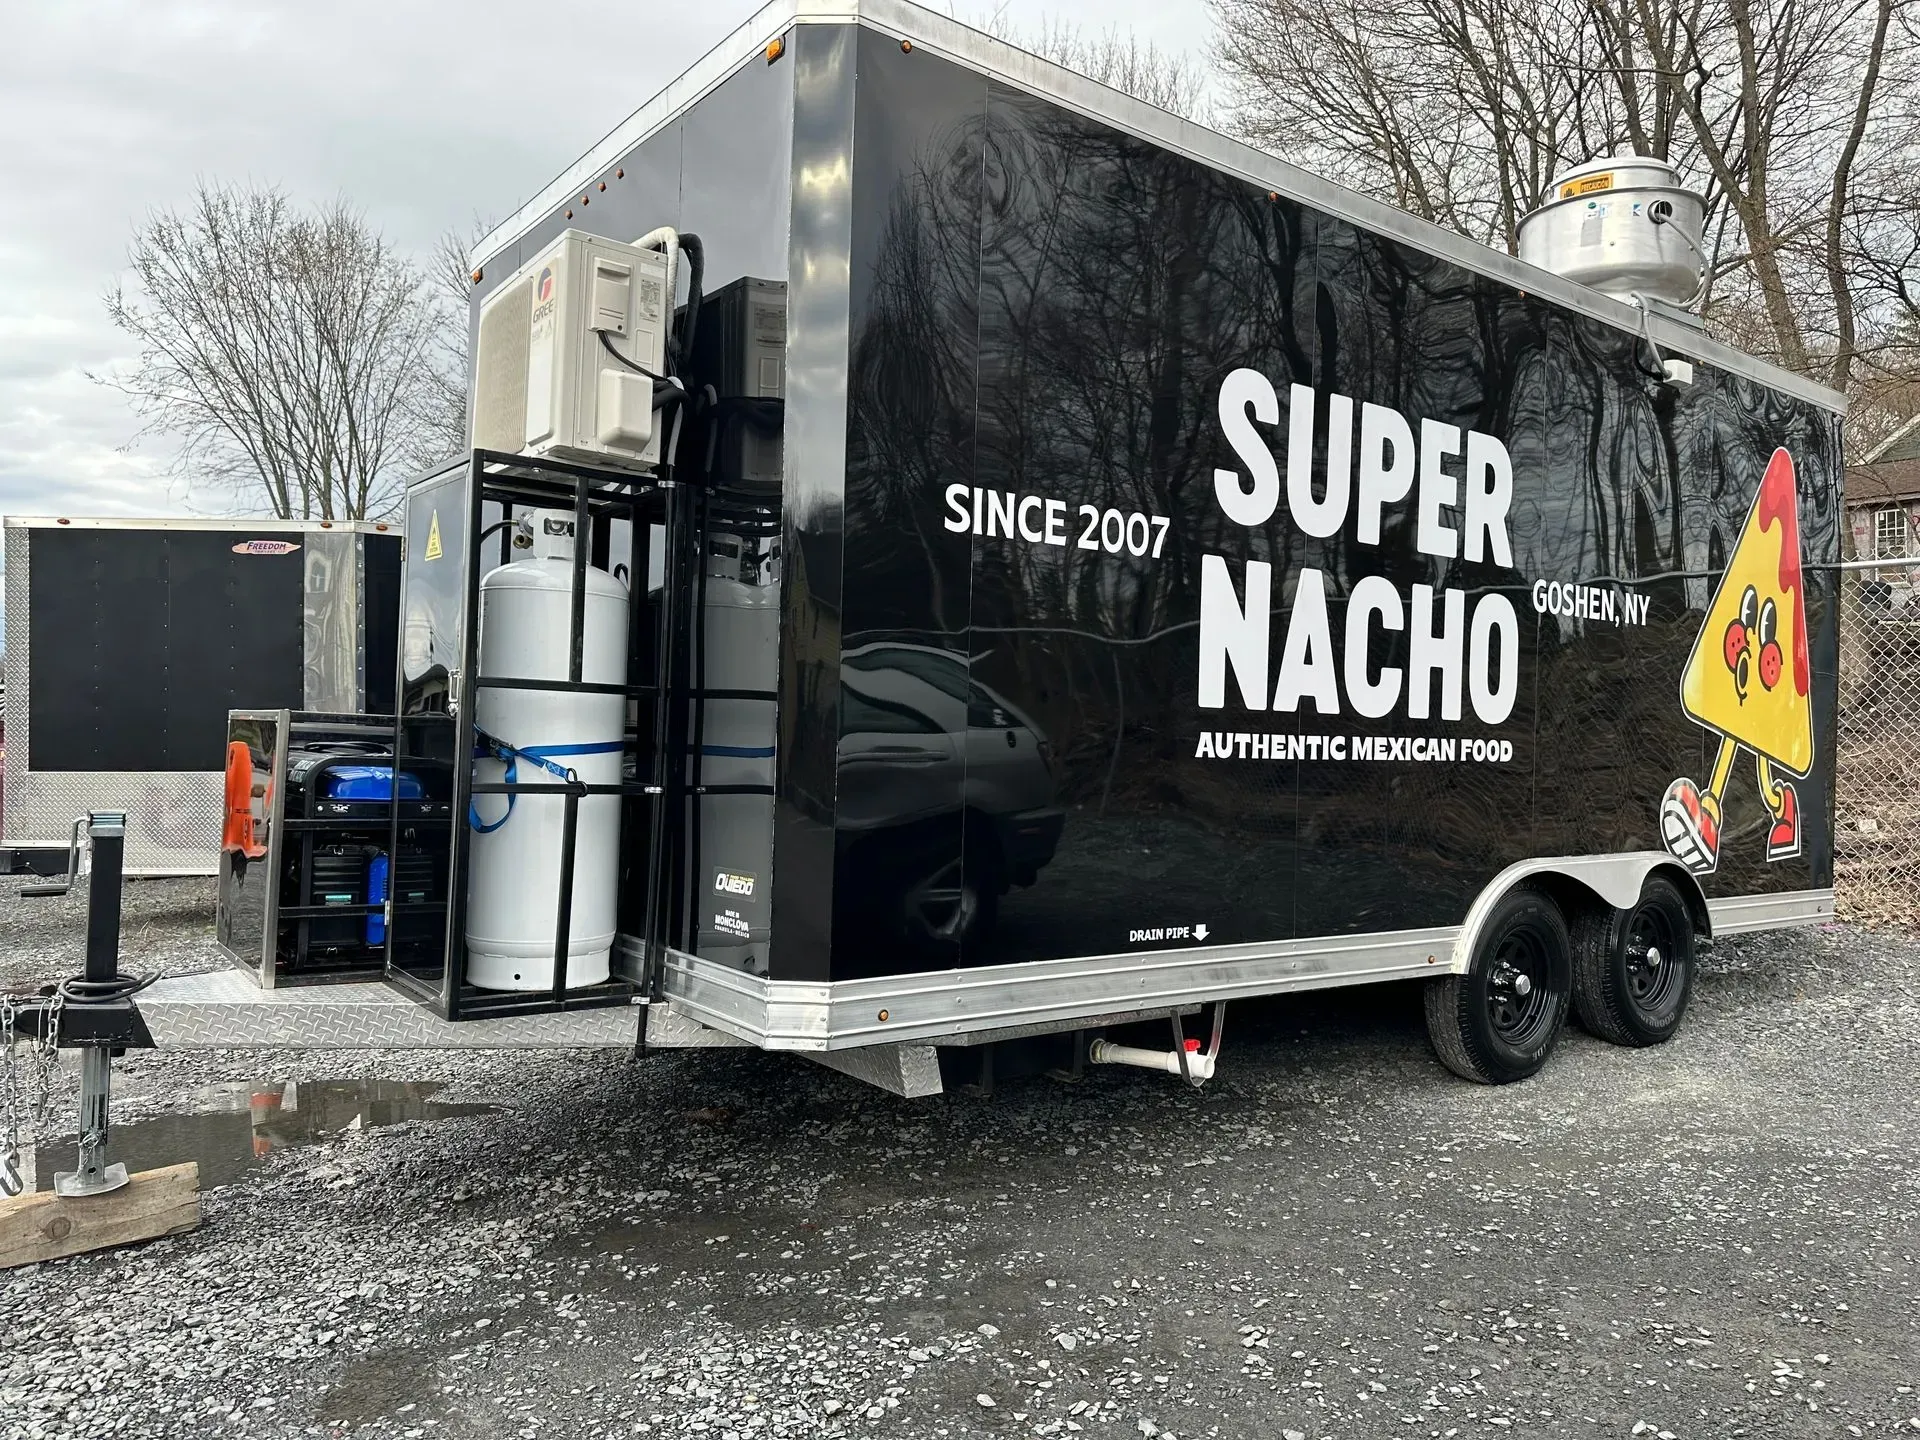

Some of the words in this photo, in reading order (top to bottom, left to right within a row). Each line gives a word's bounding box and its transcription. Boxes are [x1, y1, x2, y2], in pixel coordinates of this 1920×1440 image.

[533, 299, 554, 323] GREE
[1213, 367, 1514, 569] SUPER
[944, 483, 1067, 546] SINCE
[1077, 504, 1171, 559] 2007
[247, 542, 286, 550] FREEDOM
[1532, 578, 1620, 628] GOSHEN,
[1624, 592, 1651, 626] NY
[1197, 553, 1519, 725] NACHO
[1194, 731, 1347, 760] AUTHENTIC
[1351, 736, 1456, 762] MEXICAN
[1460, 738, 1513, 762] FOOD
[715, 914, 749, 932] MONCLOVA
[1129, 928, 1164, 942] DRAIN
[1166, 926, 1190, 939] PIPE
